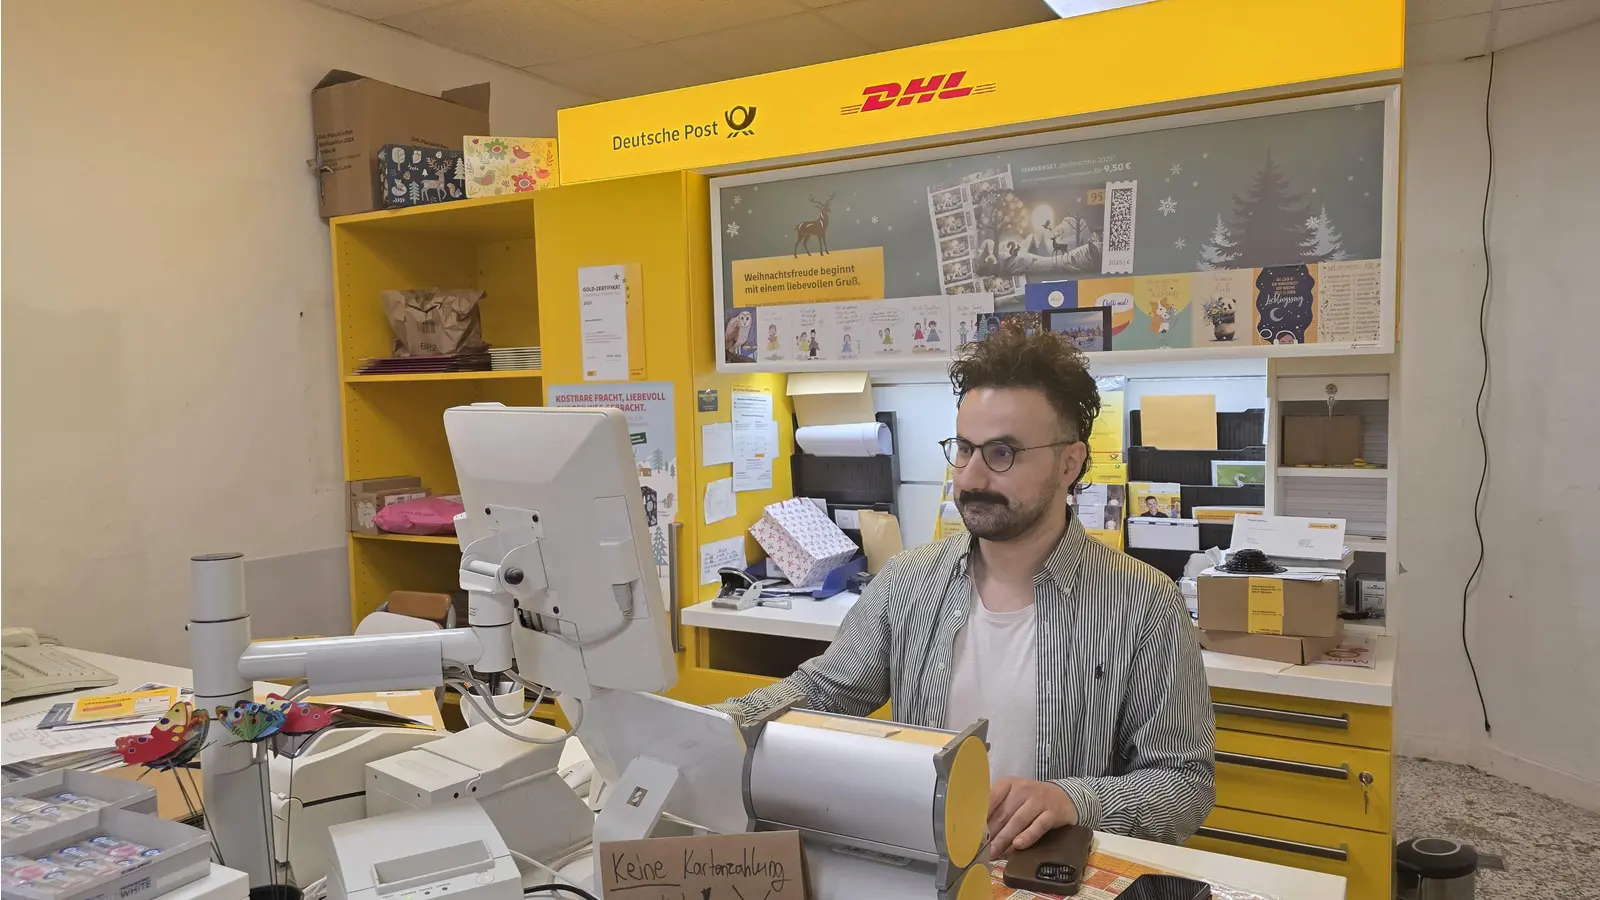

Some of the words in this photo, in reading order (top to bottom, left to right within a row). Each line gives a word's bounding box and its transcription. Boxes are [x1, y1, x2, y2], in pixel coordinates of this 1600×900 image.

[861, 71, 974, 112] DHL
[613, 128, 680, 150] Deutsche
[684, 121, 718, 140] Post
[1104, 163, 1123, 173] 9,50
[1125, 162, 1132, 170] €
[1090, 192, 1104, 202] 95
[744, 267, 819, 282] Weihnachtsfreude
[820, 265, 856, 276] beginnt
[582, 284, 621, 293] GOLD-ZERTIFIKAT
[744, 283, 759, 293] mit
[760, 282, 785, 293] einem
[786, 280, 833, 292] liebevollen
[835, 277, 861, 287] Gruß.
[420, 342, 437, 352] BP2
[555, 394, 593, 403] KOSTBARE
[594, 393, 625, 403] FRACHT,
[626, 392, 666, 401] LIEBEVOLL
[612, 853, 668, 884] Keine
[684, 847, 790, 892] Kartenzahlung
[120, 879, 152, 898] WHITE
